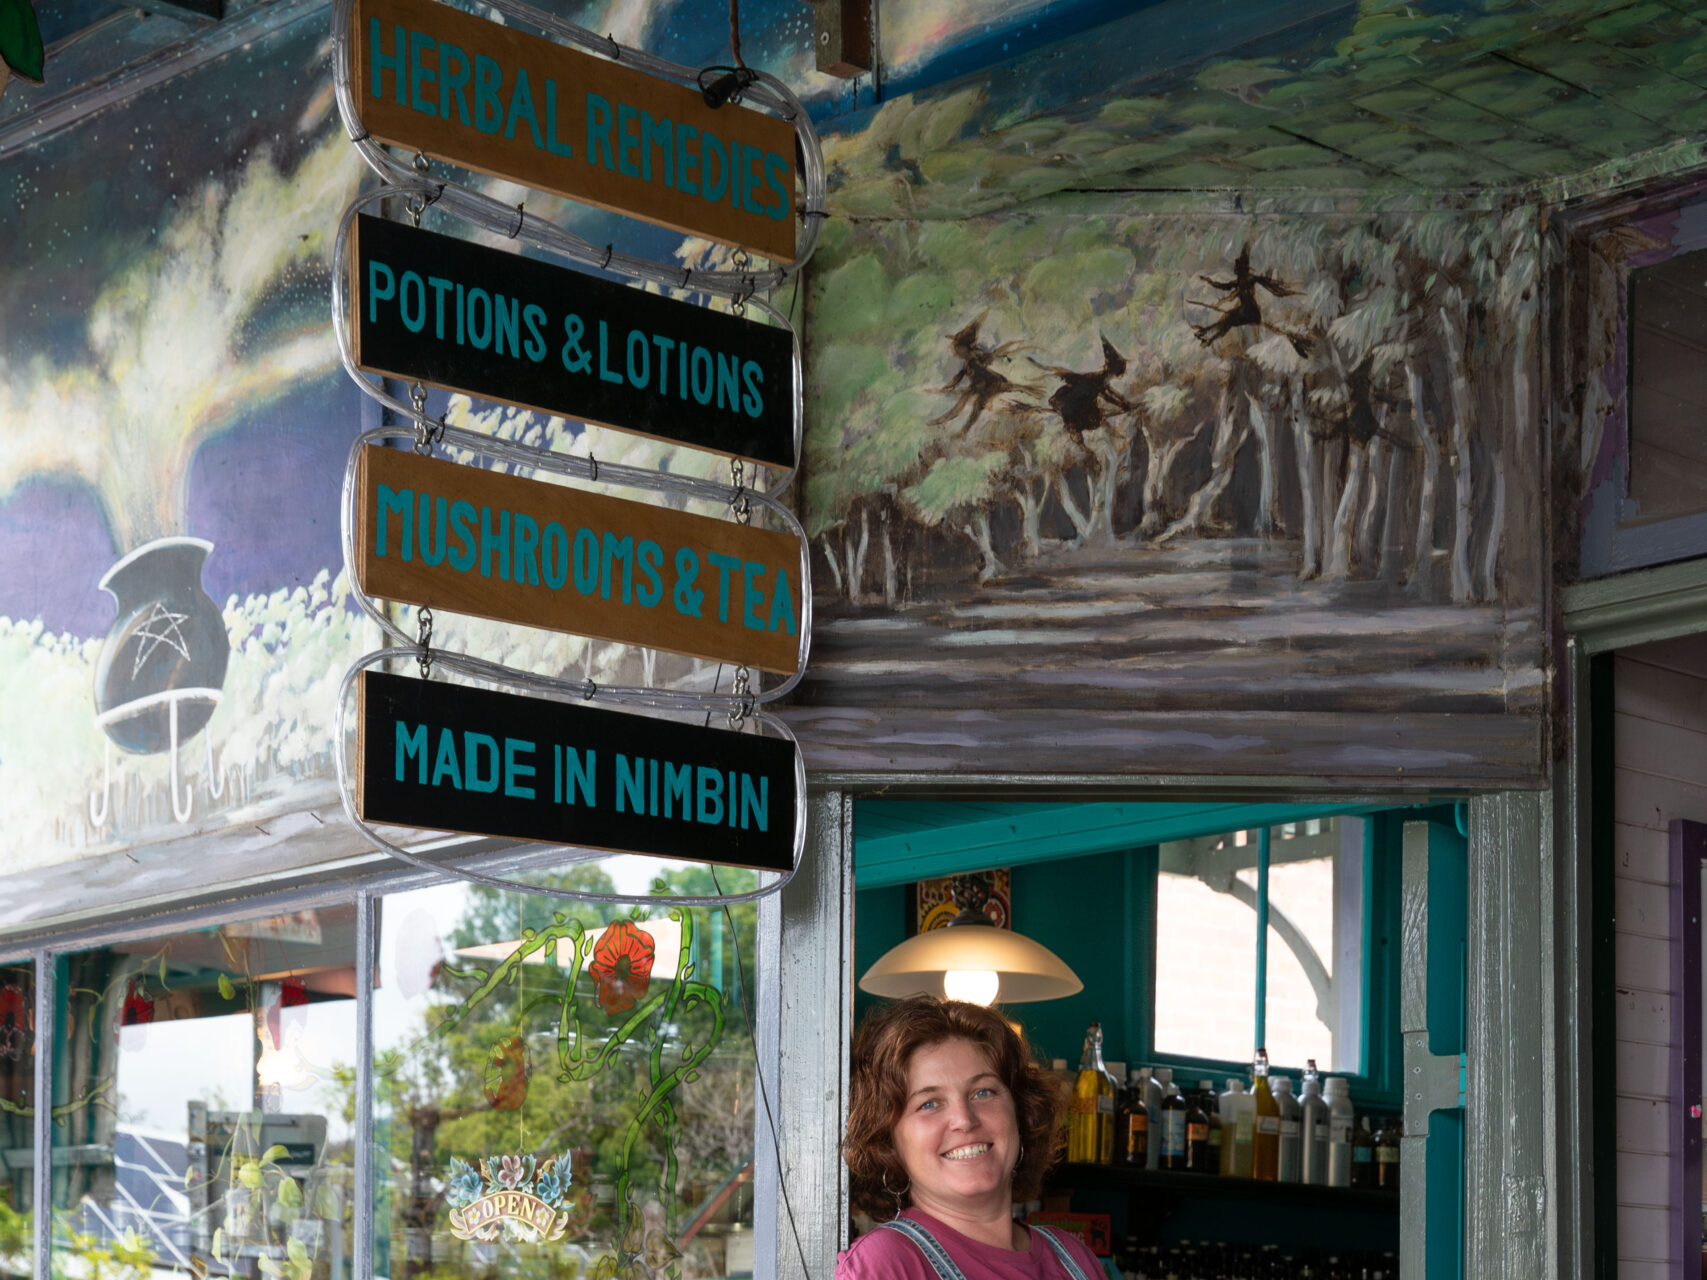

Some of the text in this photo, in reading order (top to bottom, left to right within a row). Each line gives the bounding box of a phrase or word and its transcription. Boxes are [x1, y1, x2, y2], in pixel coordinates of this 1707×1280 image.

[369, 16, 790, 222] HERBAL REMEDIES
[368, 259, 547, 364] POTIONS
[375, 483, 664, 609] MUSHROOMS
[708, 552, 796, 635] TEA
[395, 720, 769, 832] MADE IN NIMBIN
[482, 1194, 537, 1221] OPEN
